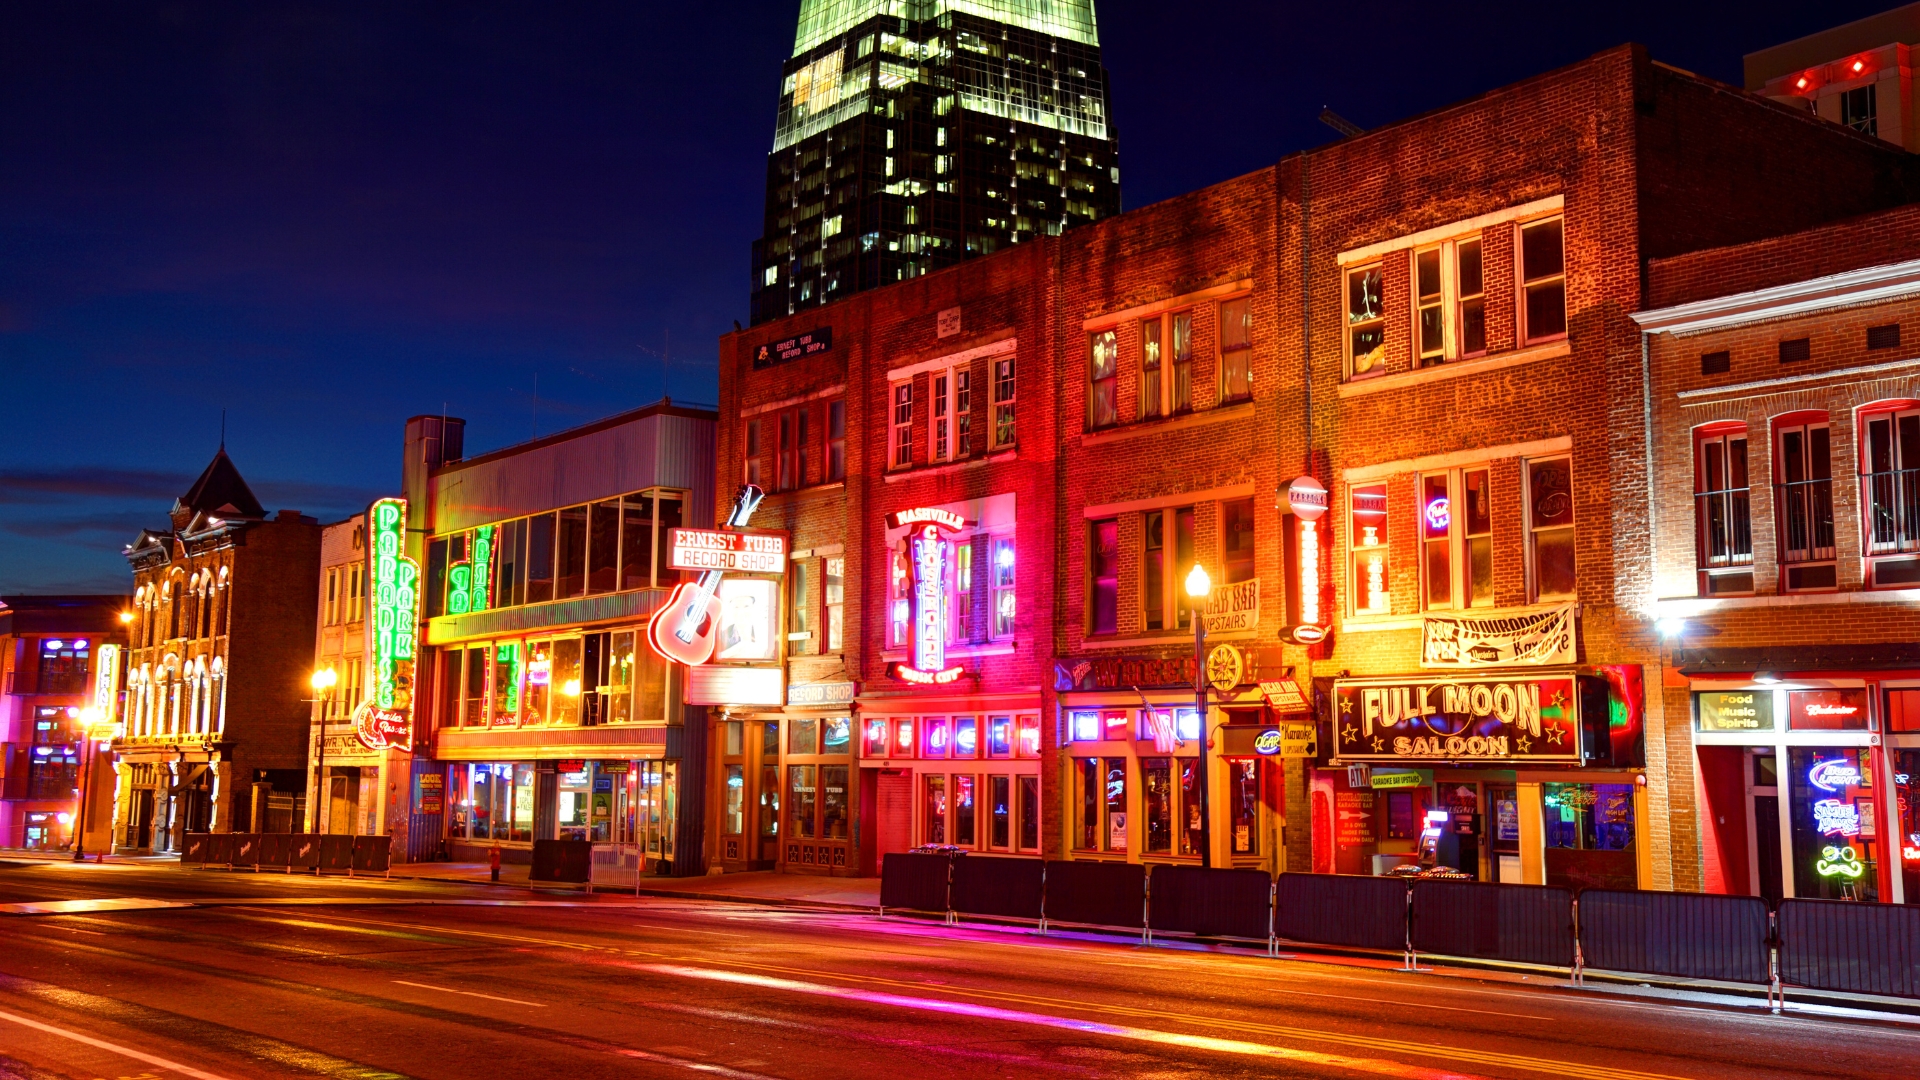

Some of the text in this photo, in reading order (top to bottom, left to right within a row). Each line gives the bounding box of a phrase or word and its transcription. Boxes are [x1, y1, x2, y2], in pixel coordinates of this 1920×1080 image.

[776, 335, 812, 352] ERNEST TUBB
[781, 342, 821, 360] RECORD SHOP
[1290, 491, 1327, 505] KARAOKE
[896, 507, 965, 530] NASHVILLE
[675, 530, 783, 553] ERNEST TUBB
[683, 550, 775, 570] RECORD SHOP
[924, 525, 938, 670] CROSSROADS
[1232, 581, 1257, 612] BAR
[378, 505, 398, 709] PARADISE
[395, 562, 415, 658] PARK
[1202, 614, 1247, 631] UPSTAIRS
[1459, 608, 1568, 641] TROUBADOURS
[1472, 649, 1497, 659] Upstairs
[789, 685, 851, 702] RECORD SHOP
[1259, 680, 1300, 694] CIGAR BAR
[1720, 695, 1753, 704] Food
[1360, 683, 1541, 737] FULL MOON
[1718, 707, 1756, 716] Music
[379, 721, 407, 734] Resort
[1717, 718, 1759, 728] Spirits
[316, 736, 357, 748] LWRENCE
[1393, 735, 1509, 758] SALOON
[1350, 766, 1370, 787] ATM
[1824, 765, 1856, 775] BUD
[1373, 777, 1392, 786] KARAOKE
[1401, 775, 1419, 784] UPSTAIRS
[1818, 775, 1862, 785] LIGHT
[1336, 792, 1374, 802] TROUBADOURS
[1814, 805, 1856, 819] SAMUEL
